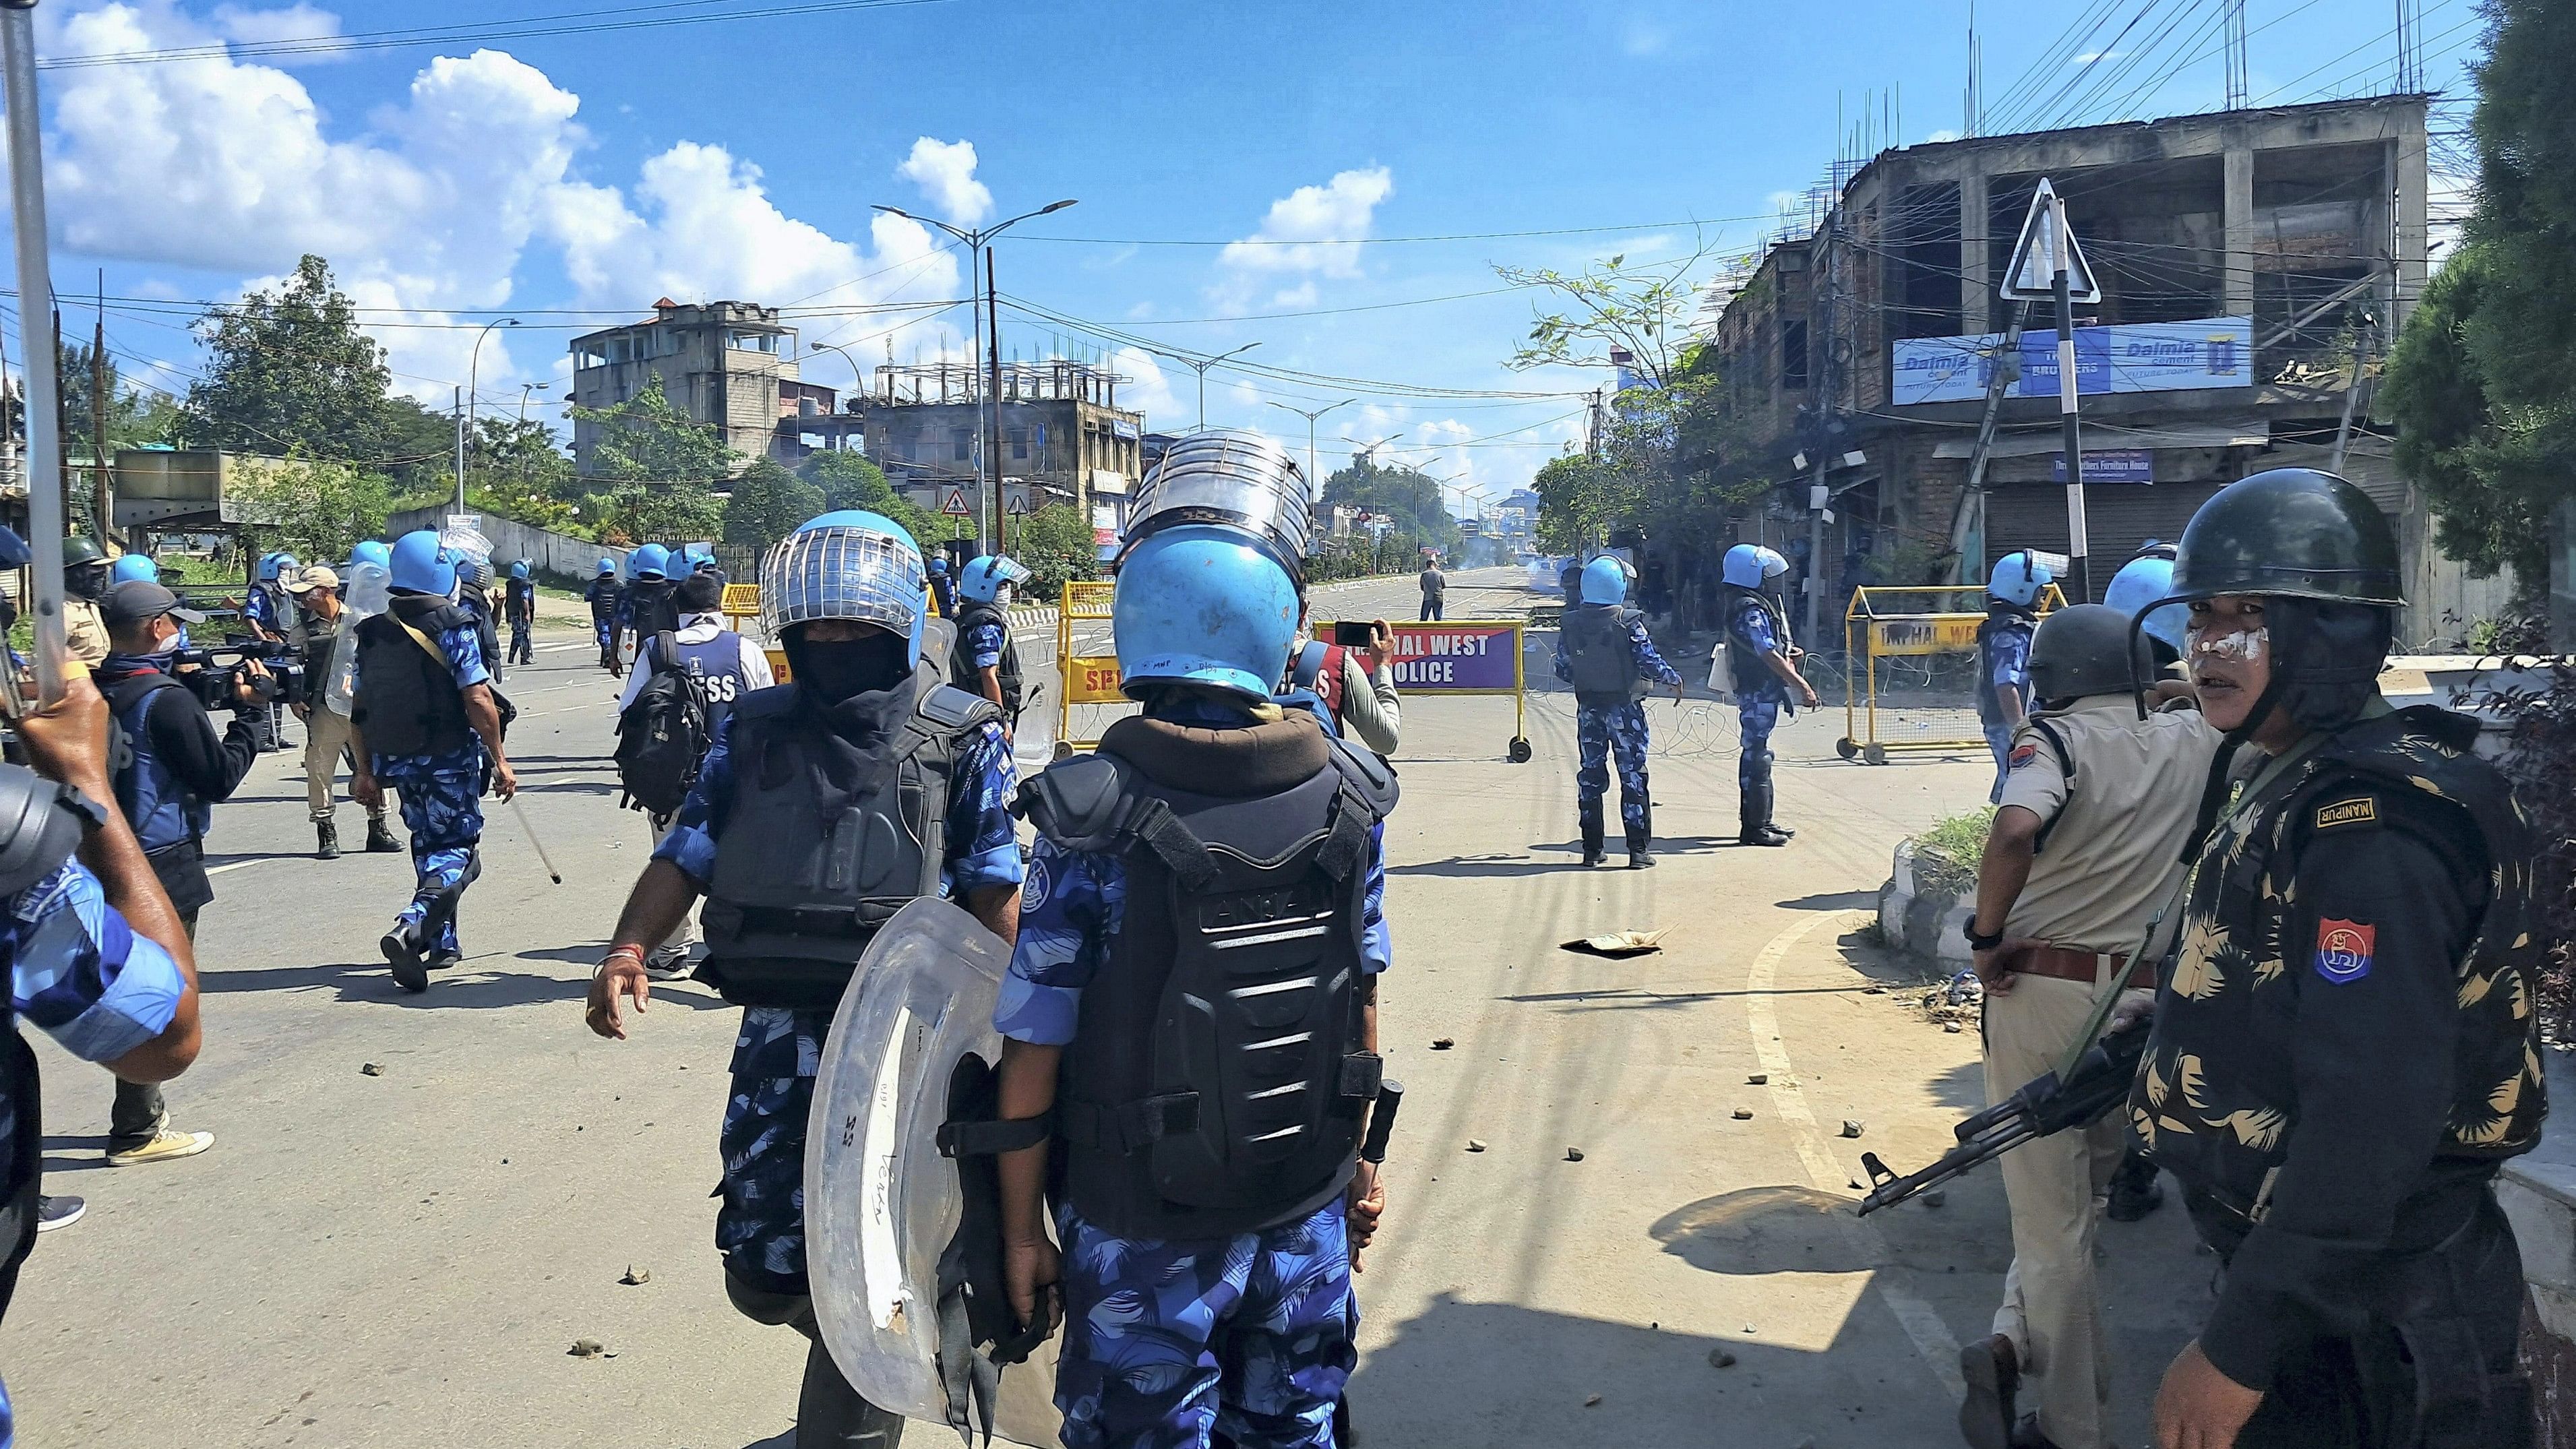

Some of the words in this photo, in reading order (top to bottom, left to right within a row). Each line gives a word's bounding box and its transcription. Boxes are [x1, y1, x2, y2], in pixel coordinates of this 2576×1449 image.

[2127, 341, 2195, 357] Dalmia
[1906, 356, 1969, 369] Dalmia
[2152, 355, 2194, 365] cement
[2032, 363, 2098, 376] BROERS
[2100, 460, 2128, 470] Furniture
[2130, 460, 2149, 470] House
[1430, 635, 1489, 656] WEST
[1390, 661, 1454, 683] OLICE
[2321, 802, 2370, 822] MANIPUR
